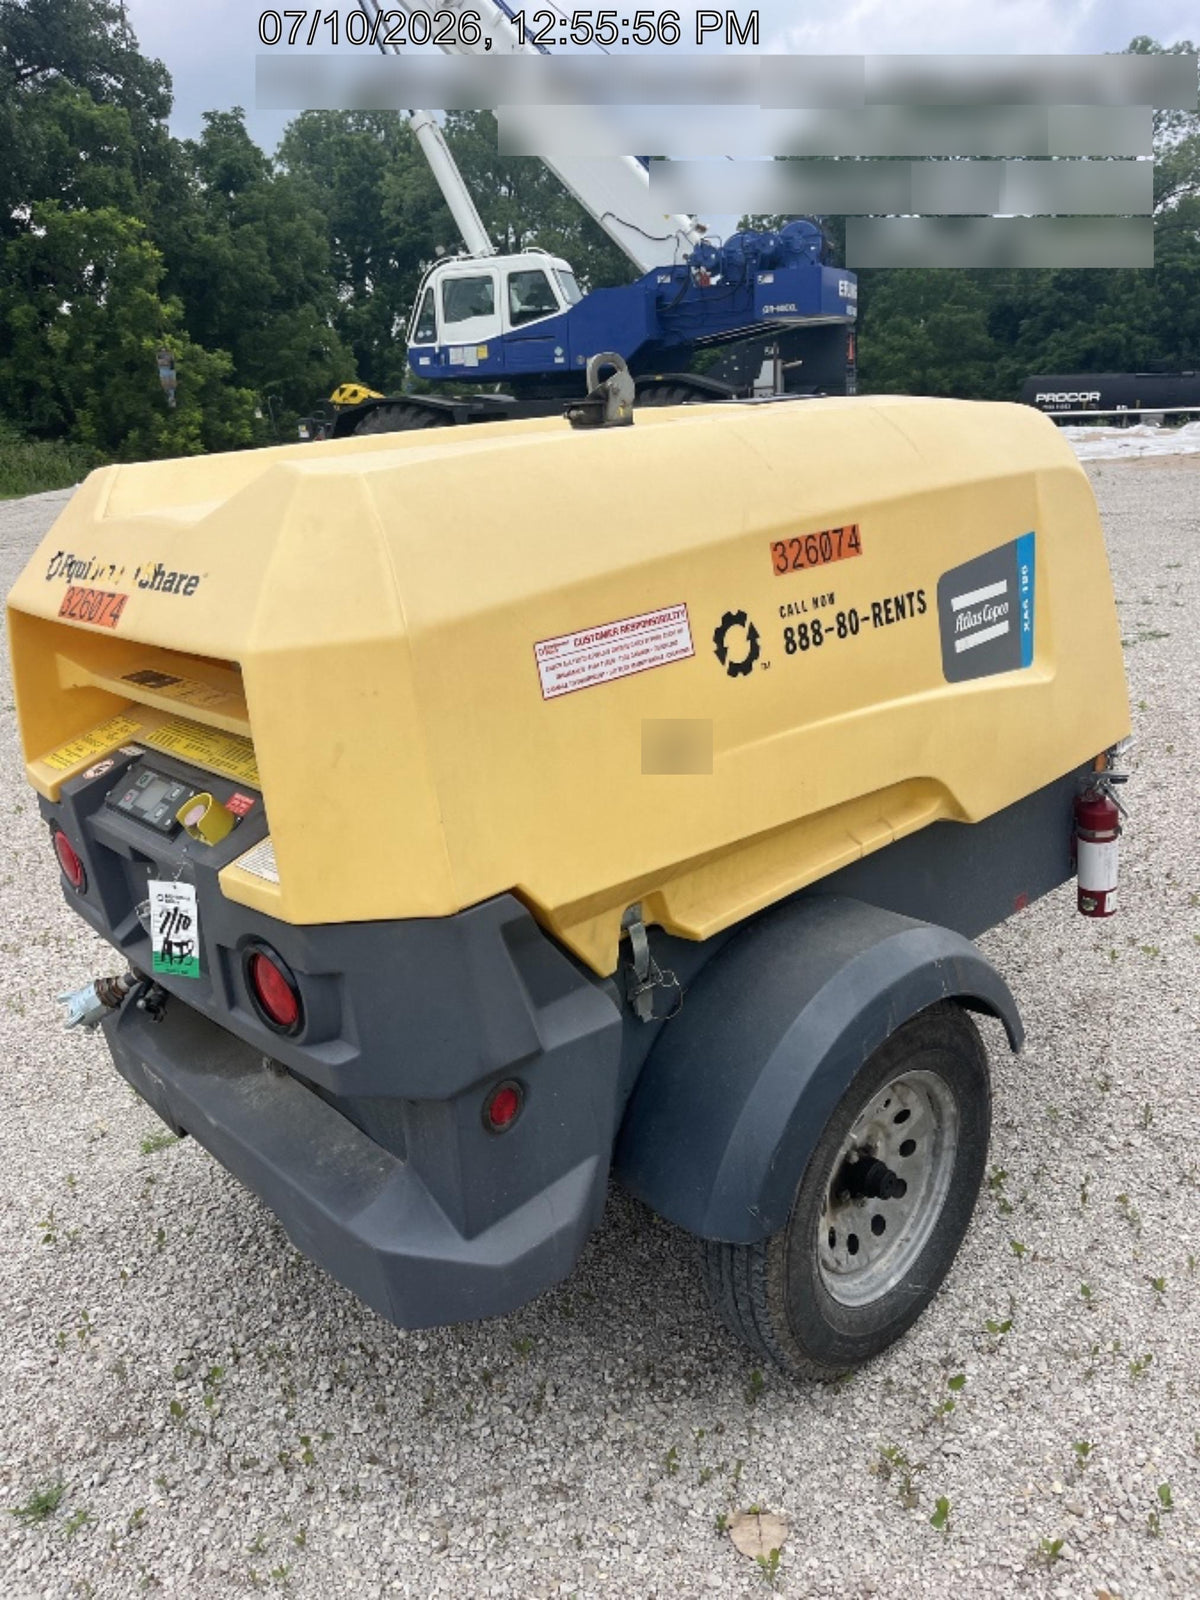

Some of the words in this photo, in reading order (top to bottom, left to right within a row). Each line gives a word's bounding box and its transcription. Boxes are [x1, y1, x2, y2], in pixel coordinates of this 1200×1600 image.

[1035, 391, 1102, 403] PROCOR
[772, 524, 861, 574] 326074
[59, 586, 128, 629] 326074
[779, 600, 808, 619] CALL
[812, 592, 836, 610] NOW
[783, 588, 928, 655] 888-80-RENTS
[954, 610, 983, 634] Atlas
[983, 602, 1010, 623] Copco
[573, 627, 620, 648] CUSTOMER
[620, 609, 686, 635] RESPONSIBILITY
